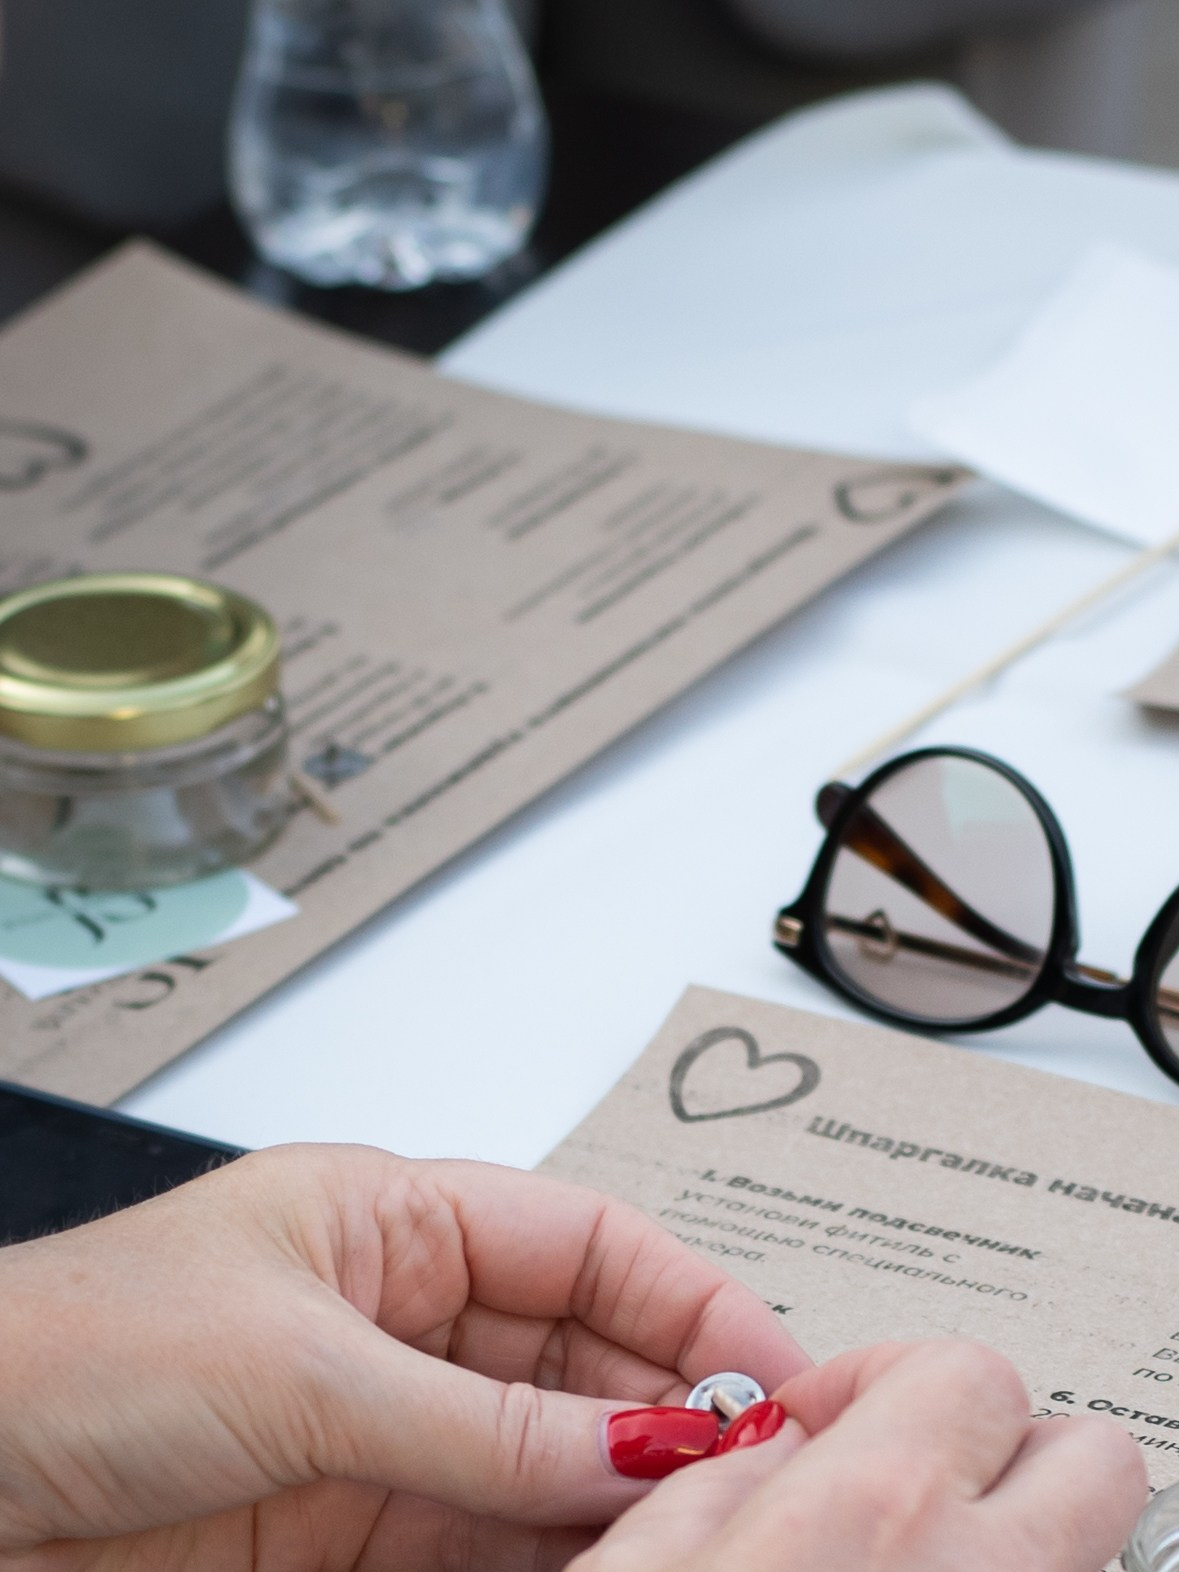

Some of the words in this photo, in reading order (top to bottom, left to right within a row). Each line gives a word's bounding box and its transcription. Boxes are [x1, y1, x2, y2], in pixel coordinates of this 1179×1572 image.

[805, 1114, 1039, 1188] Шпаргалка
[658, 1207, 806, 1250] помощью
[811, 1244, 1030, 1302] специального
[673, 1188, 821, 1231] установи
[823, 1223, 935, 1260] фитиль
[942, 1252, 963, 1265] с
[726, 1175, 845, 1213] Возьми
[847, 1206, 1043, 1261] подсвечник
[1049, 1389, 1077, 1405] 6.
[1131, 1367, 1174, 1383] по
